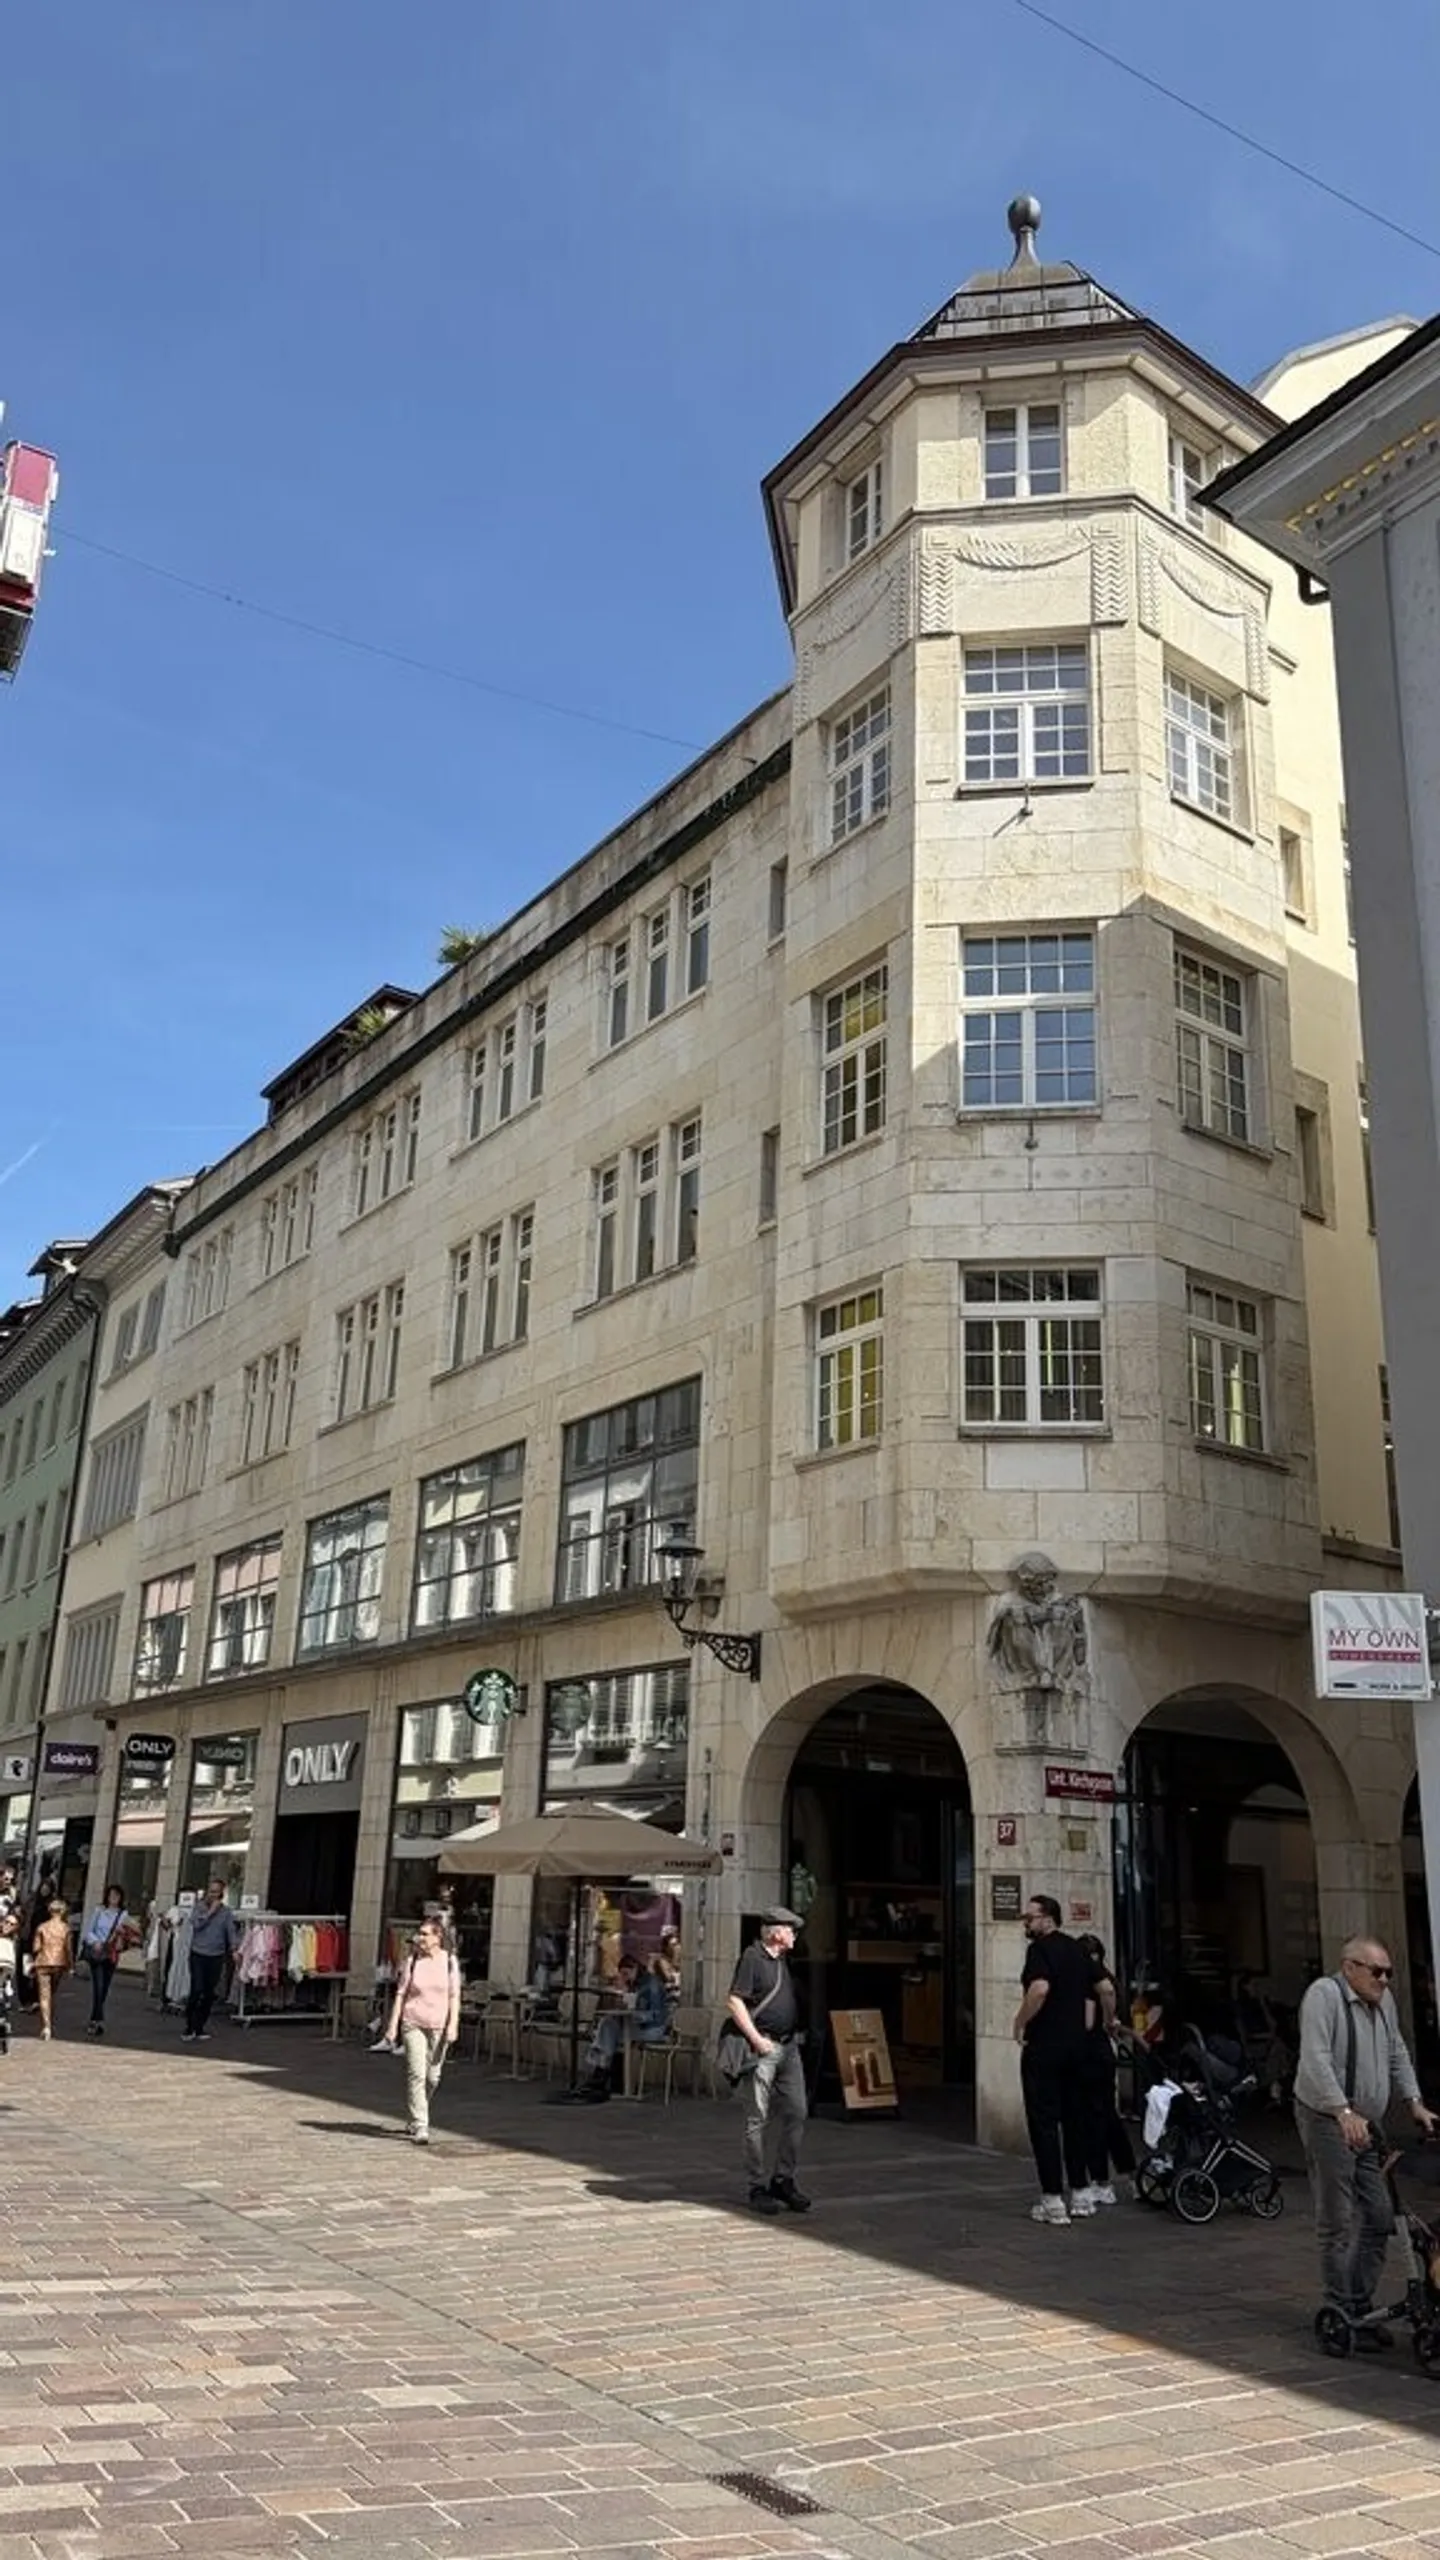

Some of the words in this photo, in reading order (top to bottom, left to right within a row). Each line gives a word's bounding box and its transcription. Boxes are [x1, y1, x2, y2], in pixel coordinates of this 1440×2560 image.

[1329, 1629, 1361, 1647] MY
[1367, 1629, 1420, 1648] OWN
[129, 1740, 172, 1754] ONLY
[285, 1740, 350, 1787] ONLY
[1000, 1822, 1013, 1838] 37
